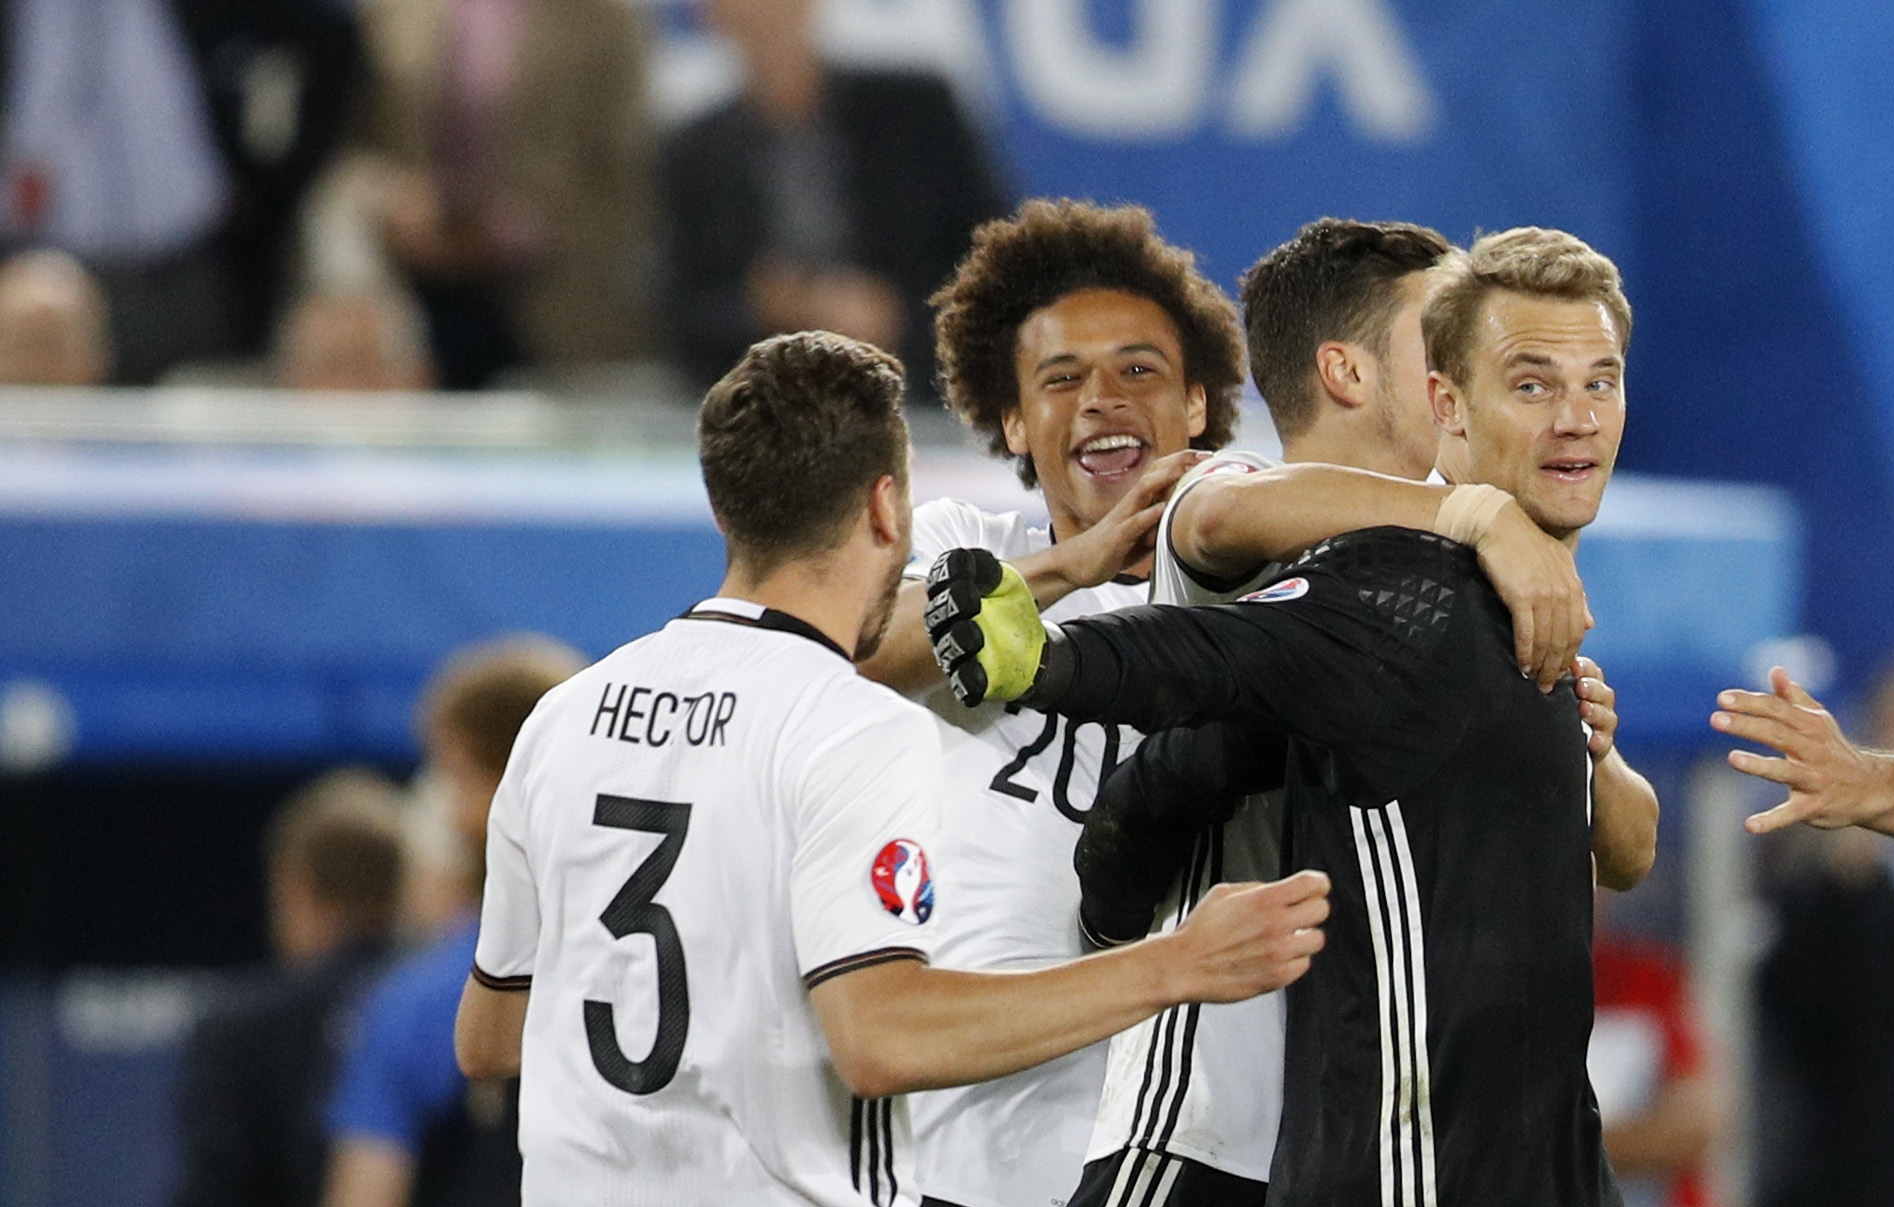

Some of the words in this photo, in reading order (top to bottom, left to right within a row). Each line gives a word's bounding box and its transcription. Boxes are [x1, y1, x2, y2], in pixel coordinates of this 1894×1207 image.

[590, 682, 737, 748] HECTOR
[988, 702, 1122, 824] 20
[583, 793, 693, 1096] 3
